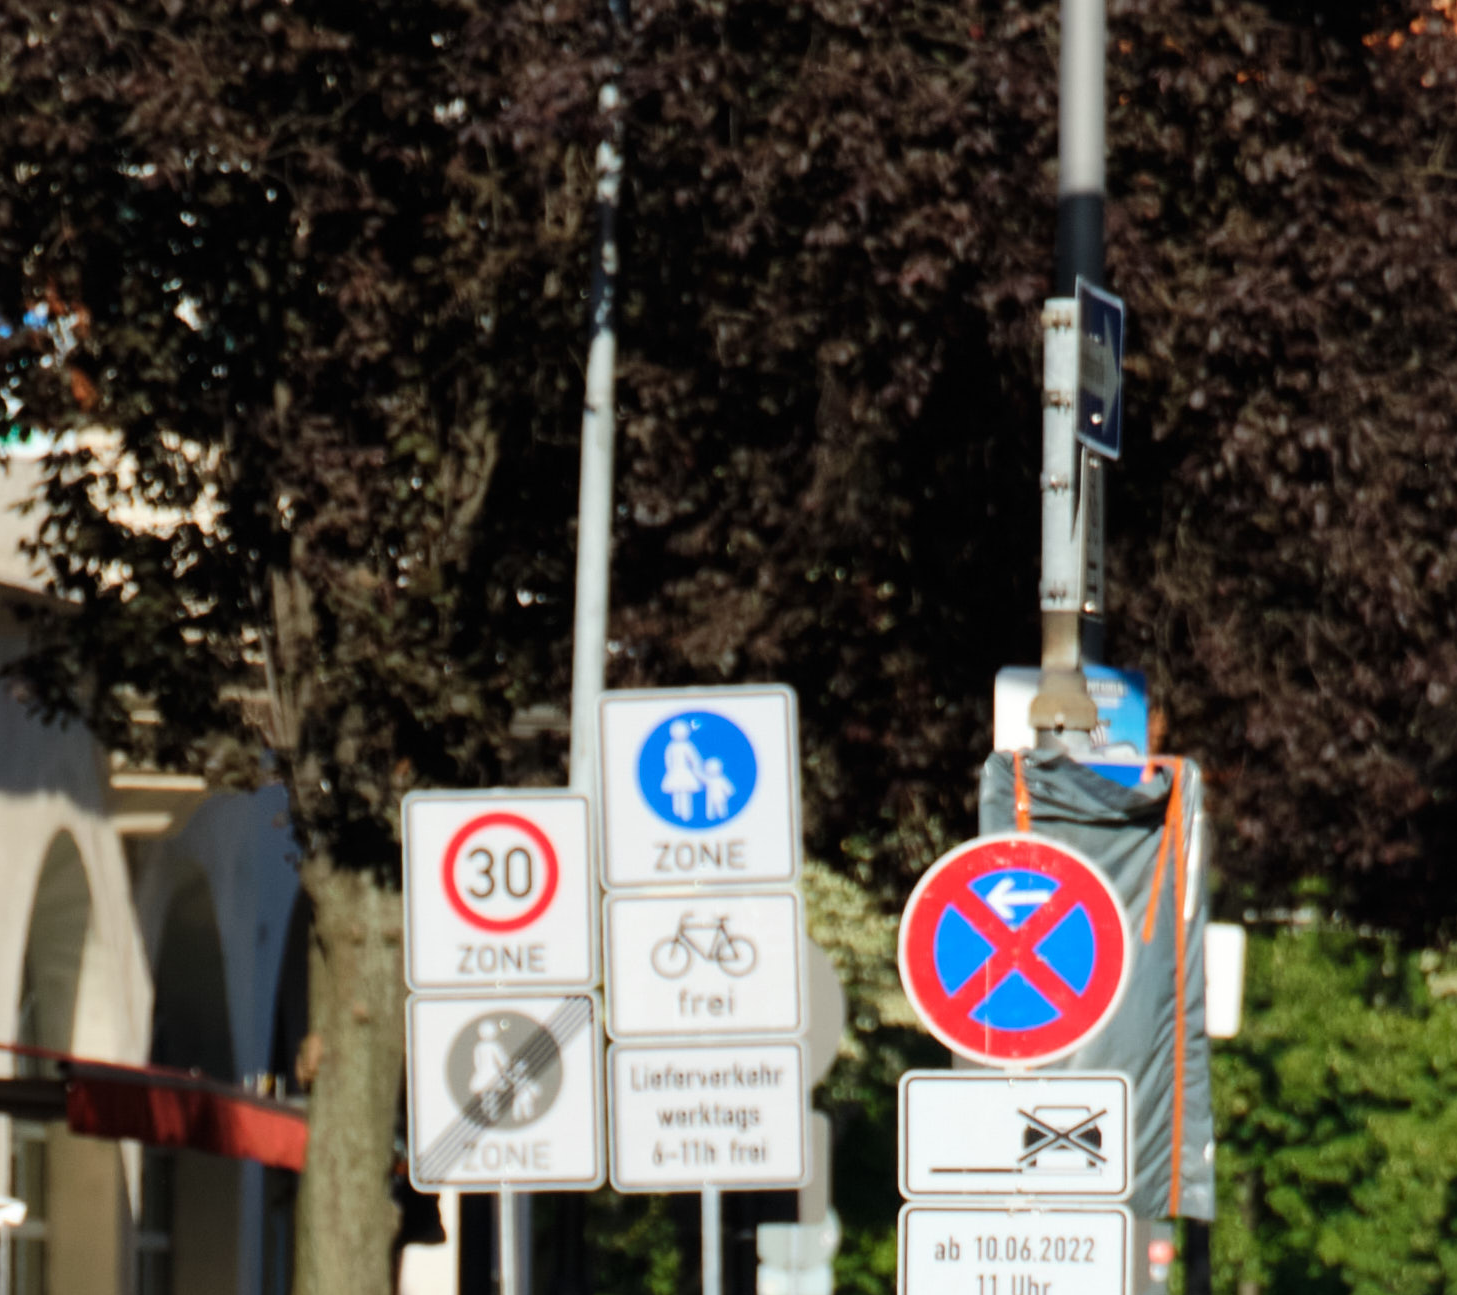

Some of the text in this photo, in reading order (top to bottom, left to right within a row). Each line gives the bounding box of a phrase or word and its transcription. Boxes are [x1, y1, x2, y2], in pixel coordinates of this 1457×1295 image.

[654, 841, 747, 872] ZONE
[465, 847, 533, 900] 30
[457, 945, 547, 973] ZONE
[678, 989, 736, 1016] frei
[629, 1065, 784, 1093] Lieferverkehr
[657, 1104, 761, 1132] werktags
[461, 1141, 551, 1171] ZONE
[729, 1140, 768, 1163] frei
[934, 1234, 1096, 1263] ab 10.06.2022
